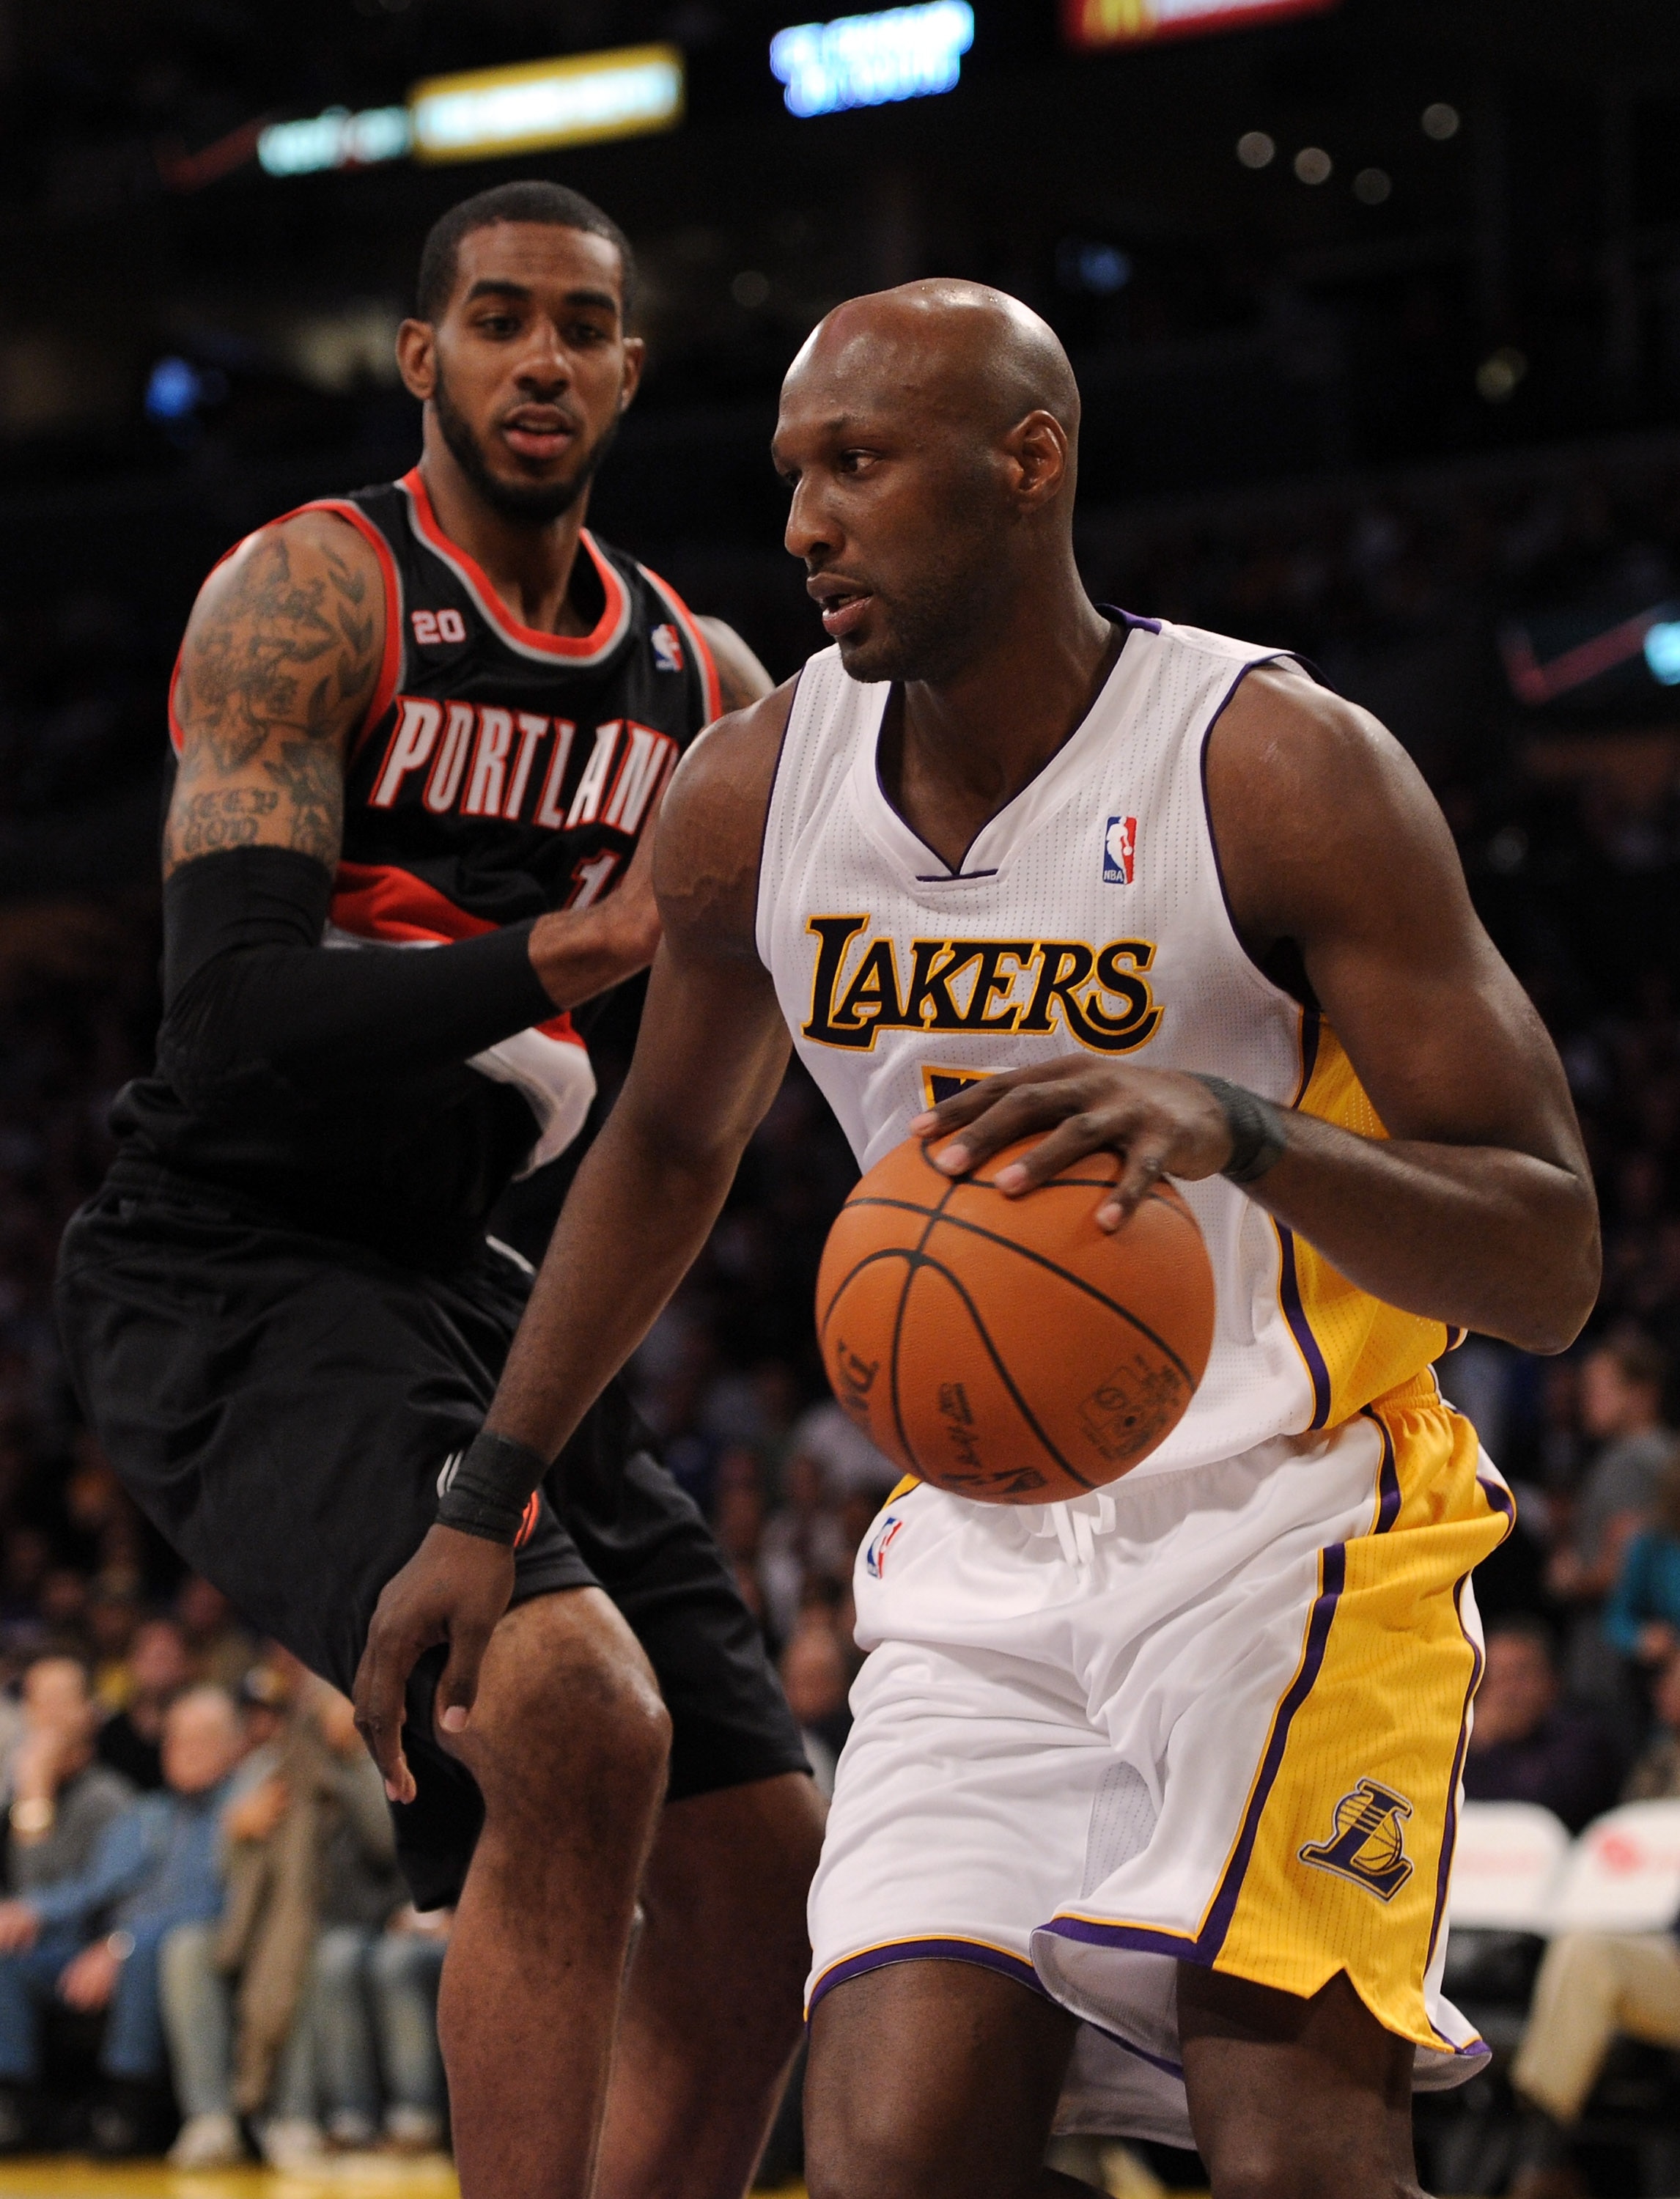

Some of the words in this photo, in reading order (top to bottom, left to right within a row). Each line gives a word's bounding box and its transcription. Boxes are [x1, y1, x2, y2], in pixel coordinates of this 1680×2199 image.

[410, 609, 465, 645] 20
[368, 695, 679, 836] PORTLAN
[564, 848, 625, 912] 1
[1103, 869, 1124, 882] NBA
[800, 913, 1164, 1056] LAKERS
